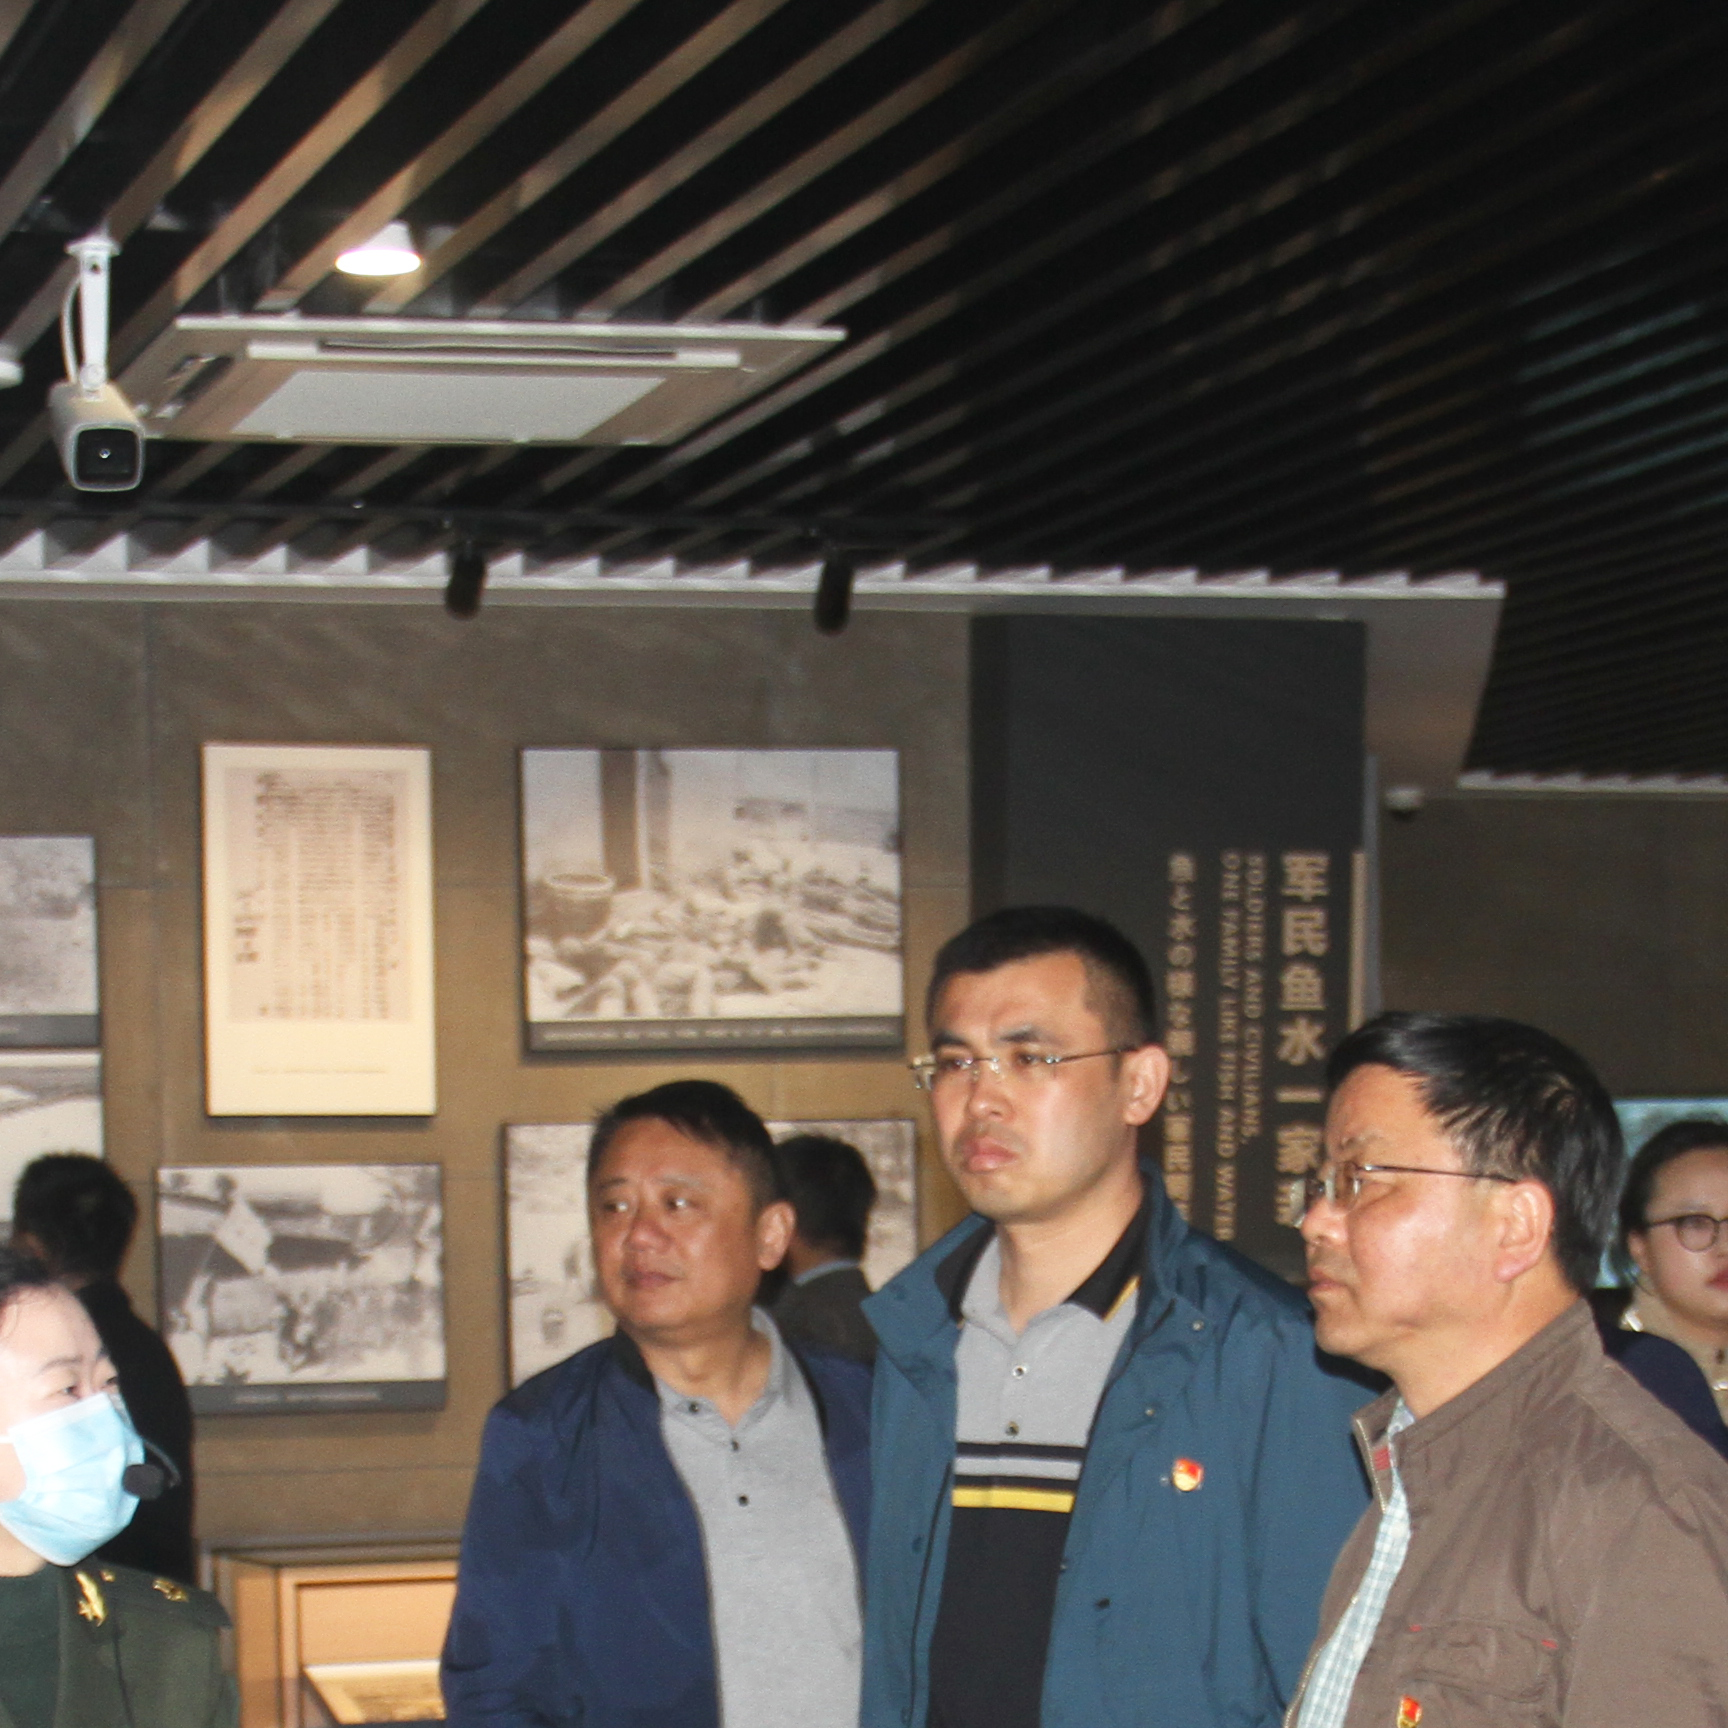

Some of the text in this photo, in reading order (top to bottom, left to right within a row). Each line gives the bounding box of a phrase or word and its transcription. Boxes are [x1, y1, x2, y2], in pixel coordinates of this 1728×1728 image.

[1221, 852, 1242, 901] ONE
[1244, 968, 1264, 1020] AND
[1217, 1106, 1238, 1159] AND
